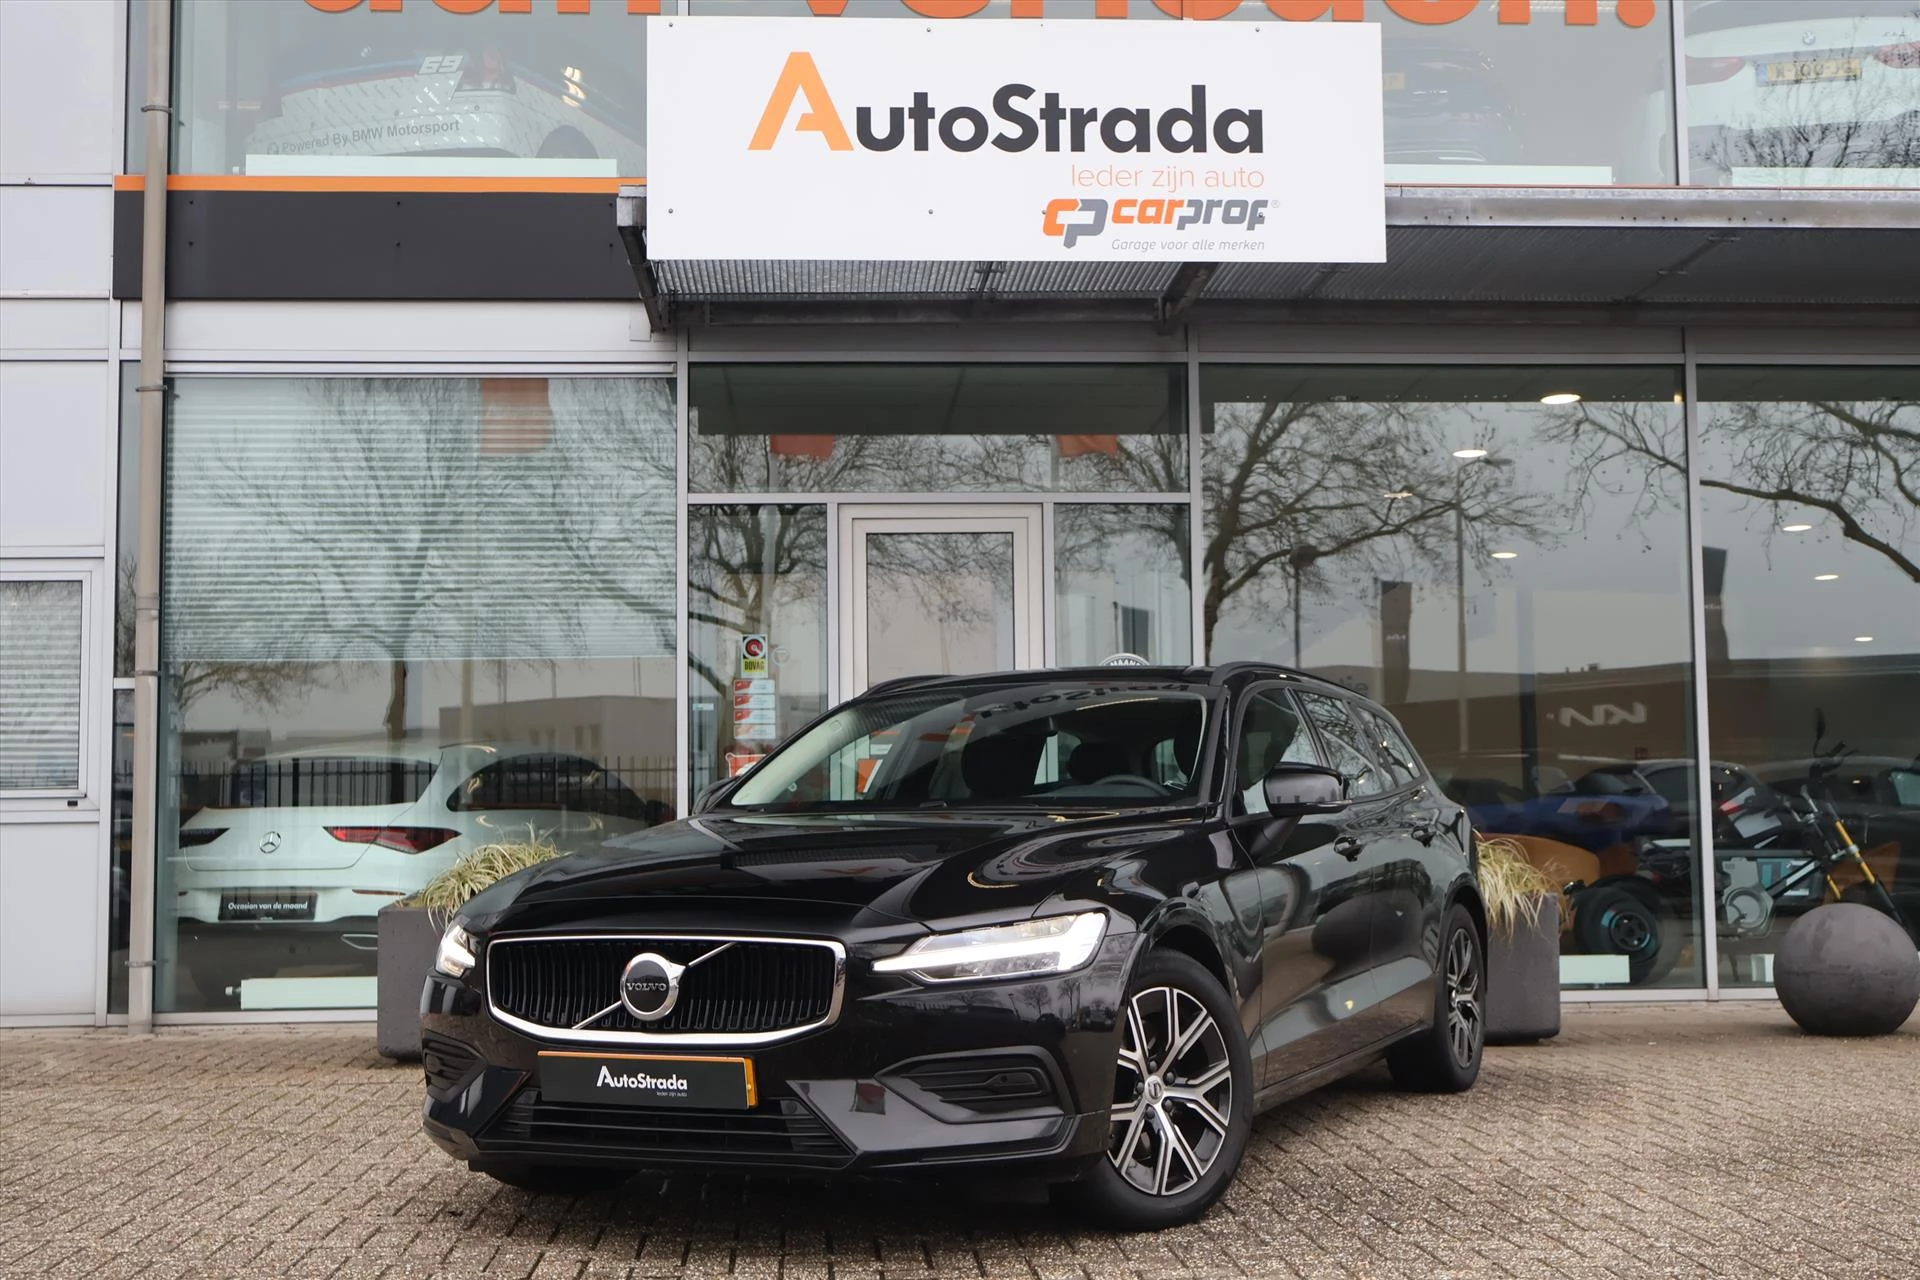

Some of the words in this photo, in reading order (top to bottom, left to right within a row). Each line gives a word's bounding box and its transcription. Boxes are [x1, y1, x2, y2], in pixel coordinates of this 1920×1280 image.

[746, 51, 1264, 154] AutoStrada
[282, 133, 330, 152] Powered
[333, 129, 350, 148] By
[352, 126, 383, 142] BMW
[387, 119, 461, 139] Motorsport
[1071, 164, 1143, 188] Ieder
[1152, 166, 1195, 193] zijn
[1204, 167, 1265, 189] auto
[1111, 199, 1269, 231] carprof
[1111, 238, 1157, 252] Garage
[1160, 241, 1189, 250] voor
[1192, 239, 1216, 250] alle
[1218, 239, 1265, 250] merken
[227, 902, 258, 910] Occasion
[273, 901, 282, 910] de
[283, 901, 308, 910] maand
[626, 982, 667, 991] VOLVO
[596, 1065, 688, 1090] AutoStrada
